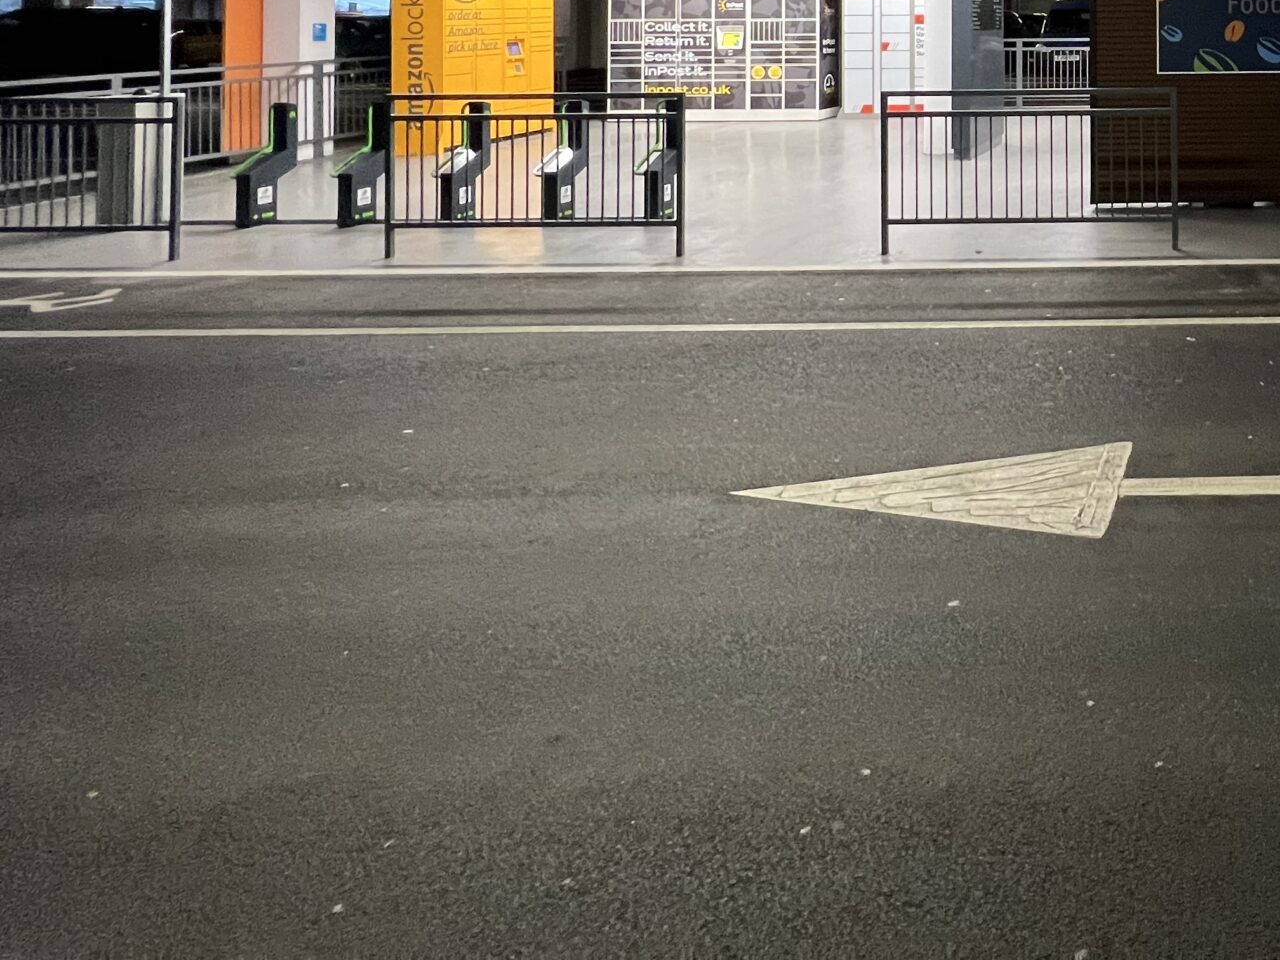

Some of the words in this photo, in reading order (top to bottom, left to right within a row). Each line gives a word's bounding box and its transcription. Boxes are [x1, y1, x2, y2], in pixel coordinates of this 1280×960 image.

[644, 21, 696, 33] Collect
[697, 21, 713, 33] it.
[644, 36, 695, 47] Return
[696, 36, 710, 47] it.
[644, 51, 682, 62] Send
[644, 66, 692, 77] InPost
